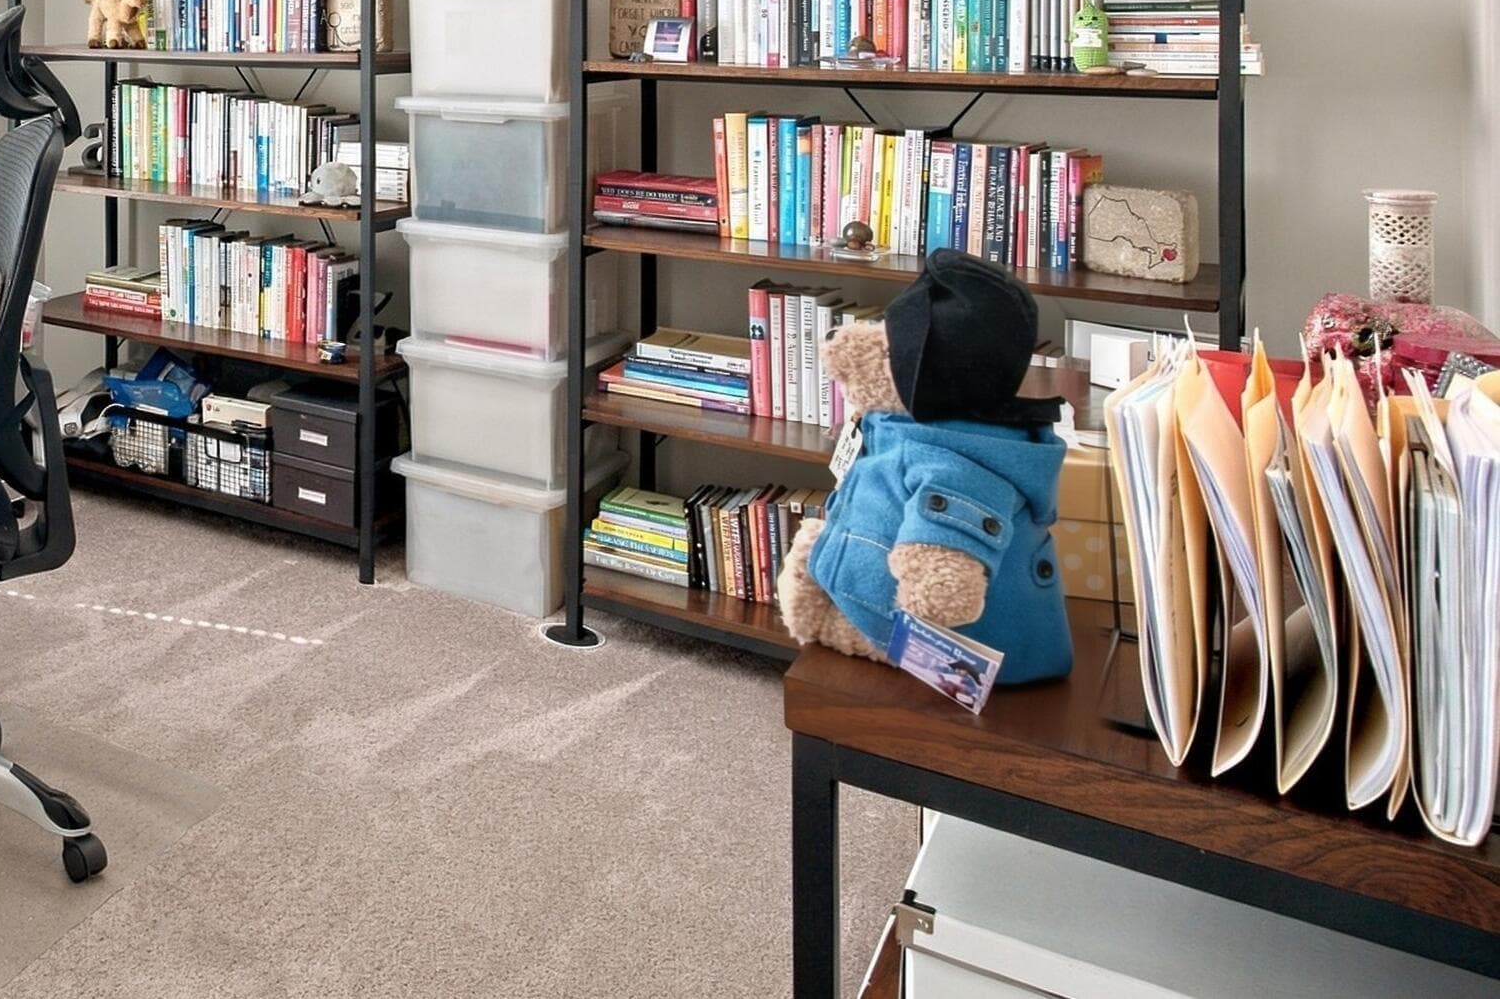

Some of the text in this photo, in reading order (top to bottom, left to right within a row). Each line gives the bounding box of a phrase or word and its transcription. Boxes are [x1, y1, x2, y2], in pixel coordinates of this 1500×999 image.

[986, 166, 998, 240] HUMAN BEHAVIOR
[995, 184, 1005, 242] SCIENCE AND
[787, 343, 798, 385] Attached
[820, 382, 830, 406] Work
